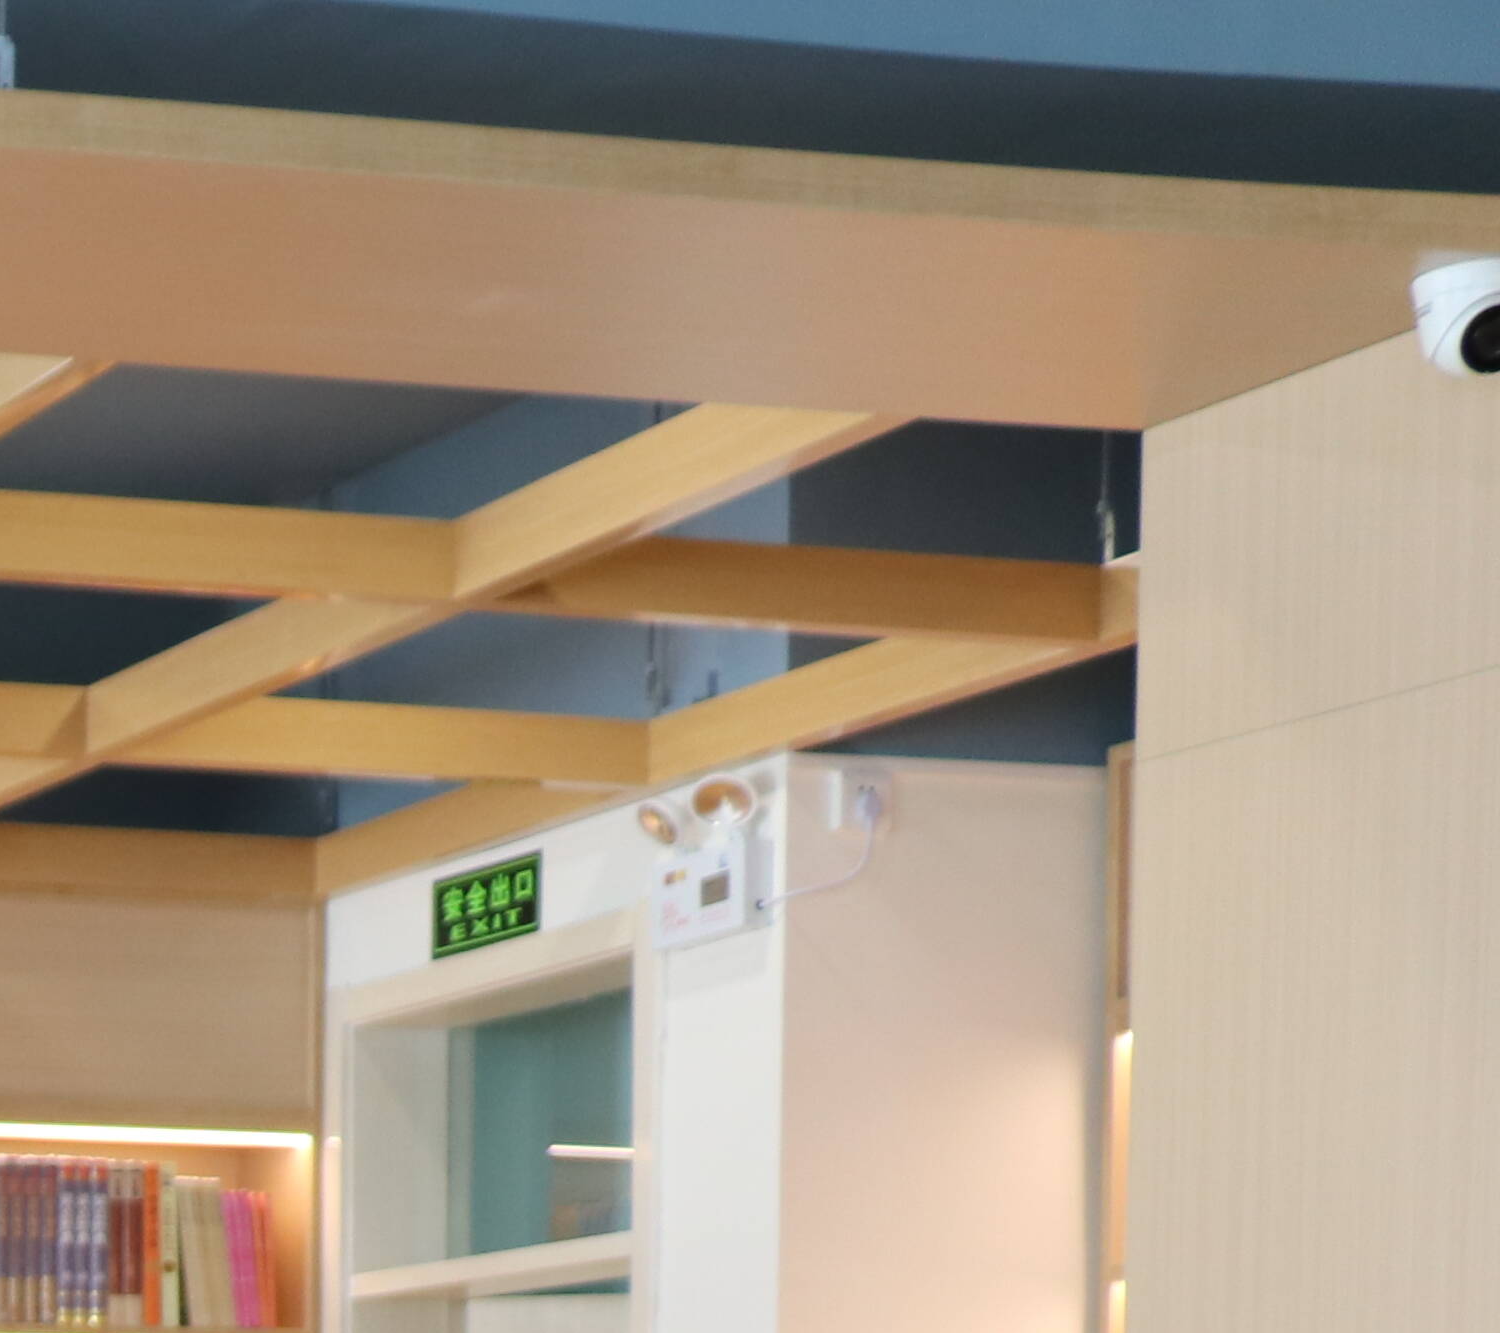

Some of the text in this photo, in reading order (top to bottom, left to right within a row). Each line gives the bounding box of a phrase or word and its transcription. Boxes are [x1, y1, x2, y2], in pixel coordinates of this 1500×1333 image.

[442, 868, 534, 923] 安全出口
[449, 907, 524, 944] EXIT
